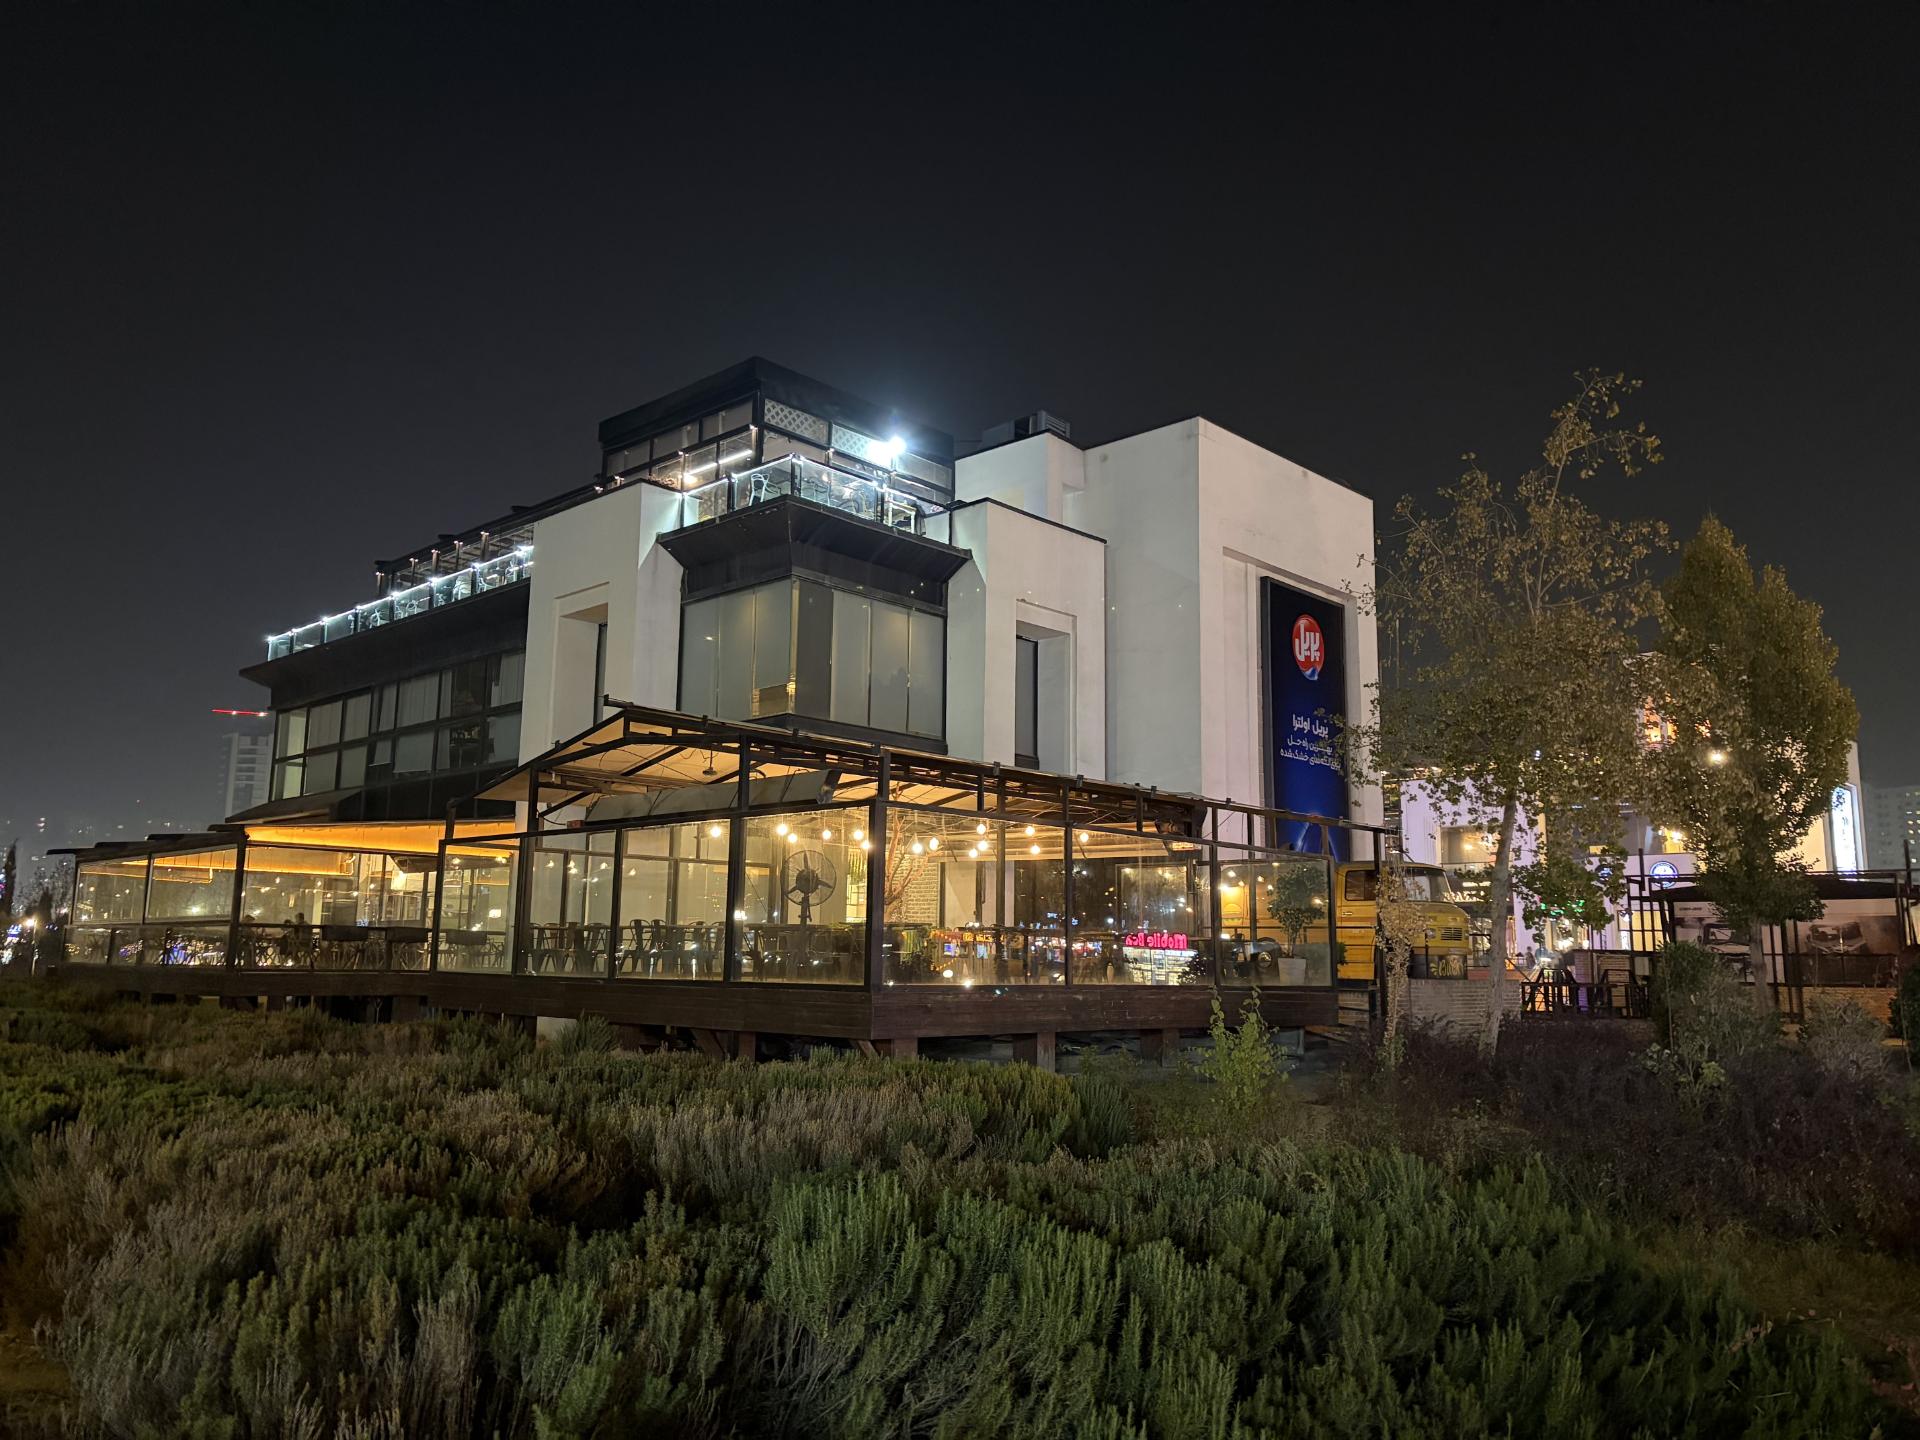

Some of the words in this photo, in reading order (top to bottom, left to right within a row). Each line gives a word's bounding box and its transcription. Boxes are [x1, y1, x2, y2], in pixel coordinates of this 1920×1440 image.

[1294, 622, 1321, 662] پریل
[1292, 713, 1311, 733] اولترا
[1312, 719, 1329, 741] پریل
